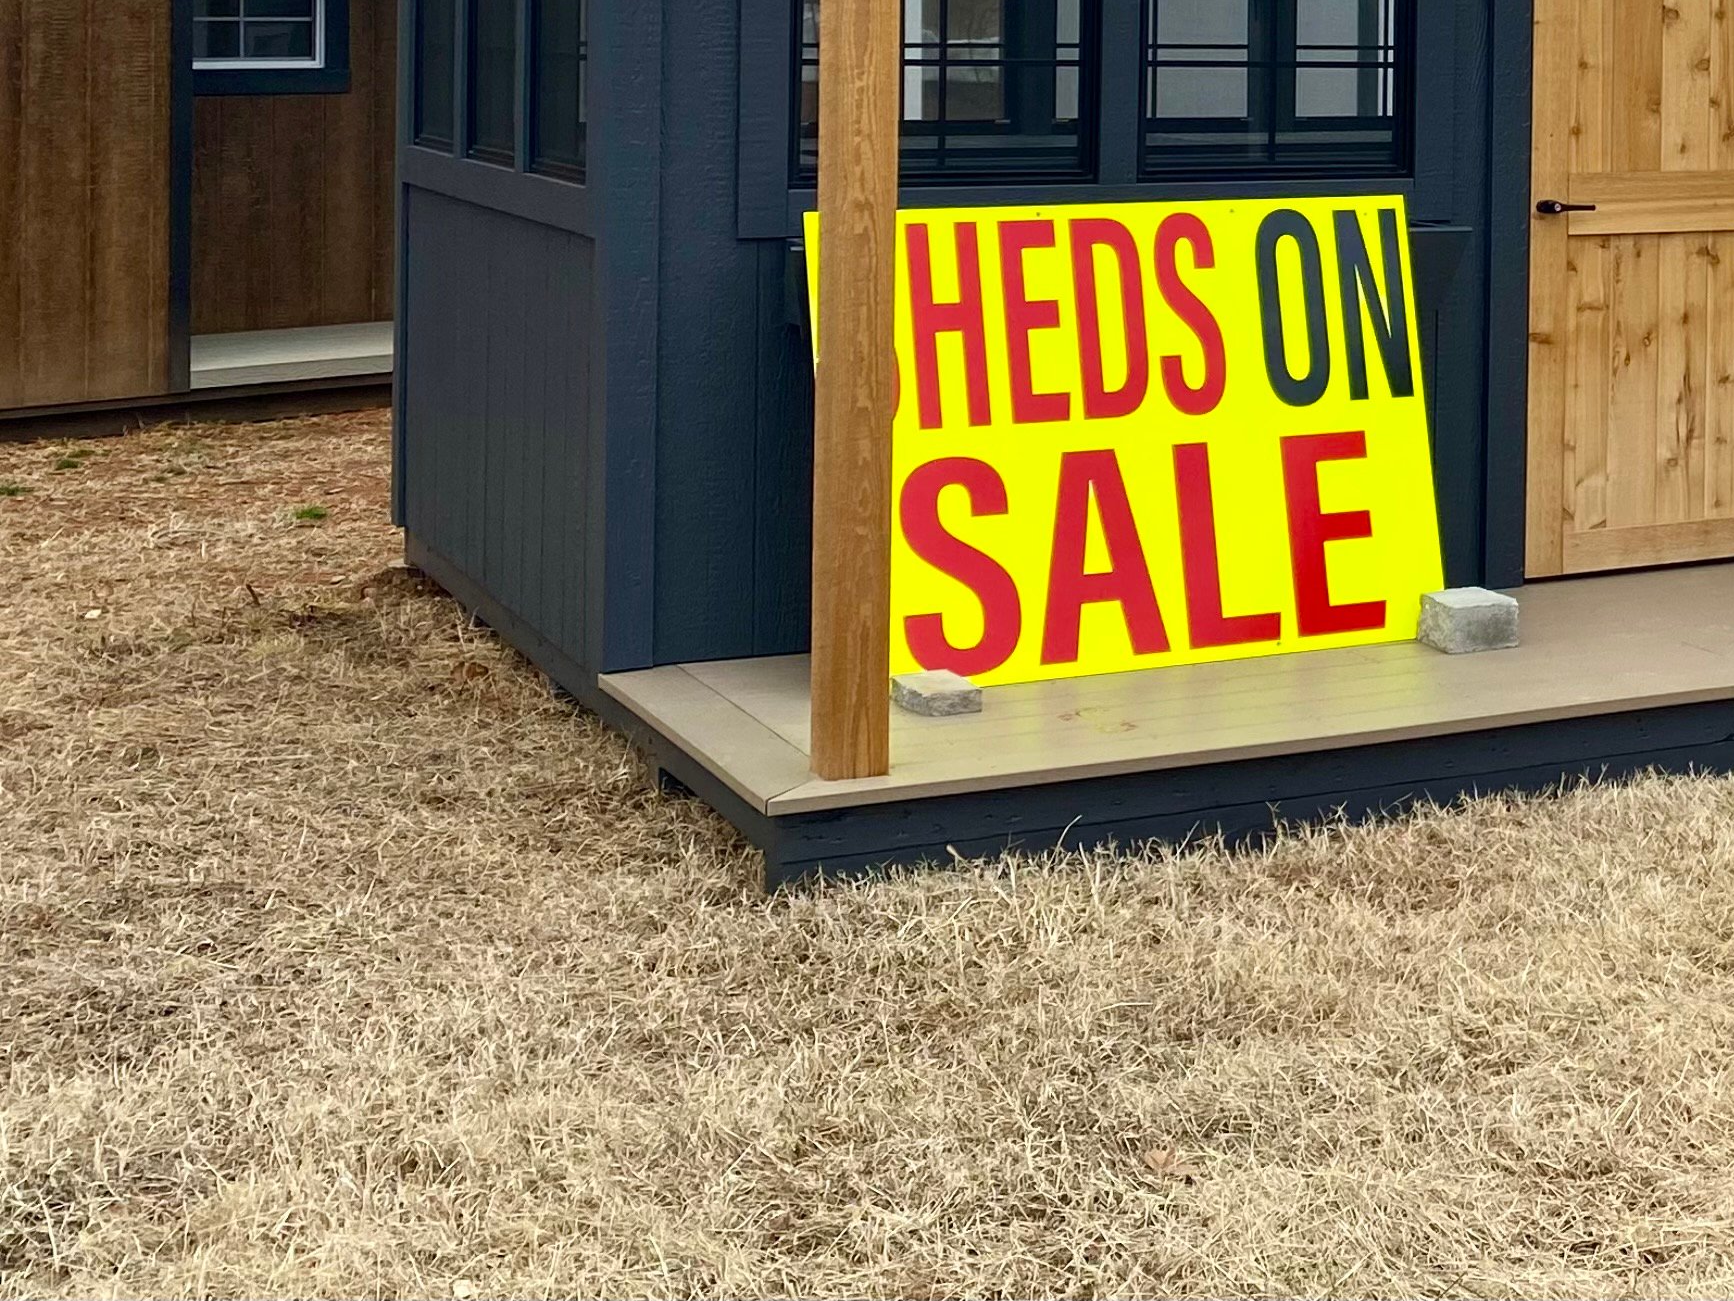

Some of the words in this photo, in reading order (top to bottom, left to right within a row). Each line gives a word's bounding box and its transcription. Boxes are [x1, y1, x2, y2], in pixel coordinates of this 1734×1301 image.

[892, 212, 1226, 429] HEDS
[1255, 208, 1414, 407] ON
[900, 430, 1386, 677] SALE
